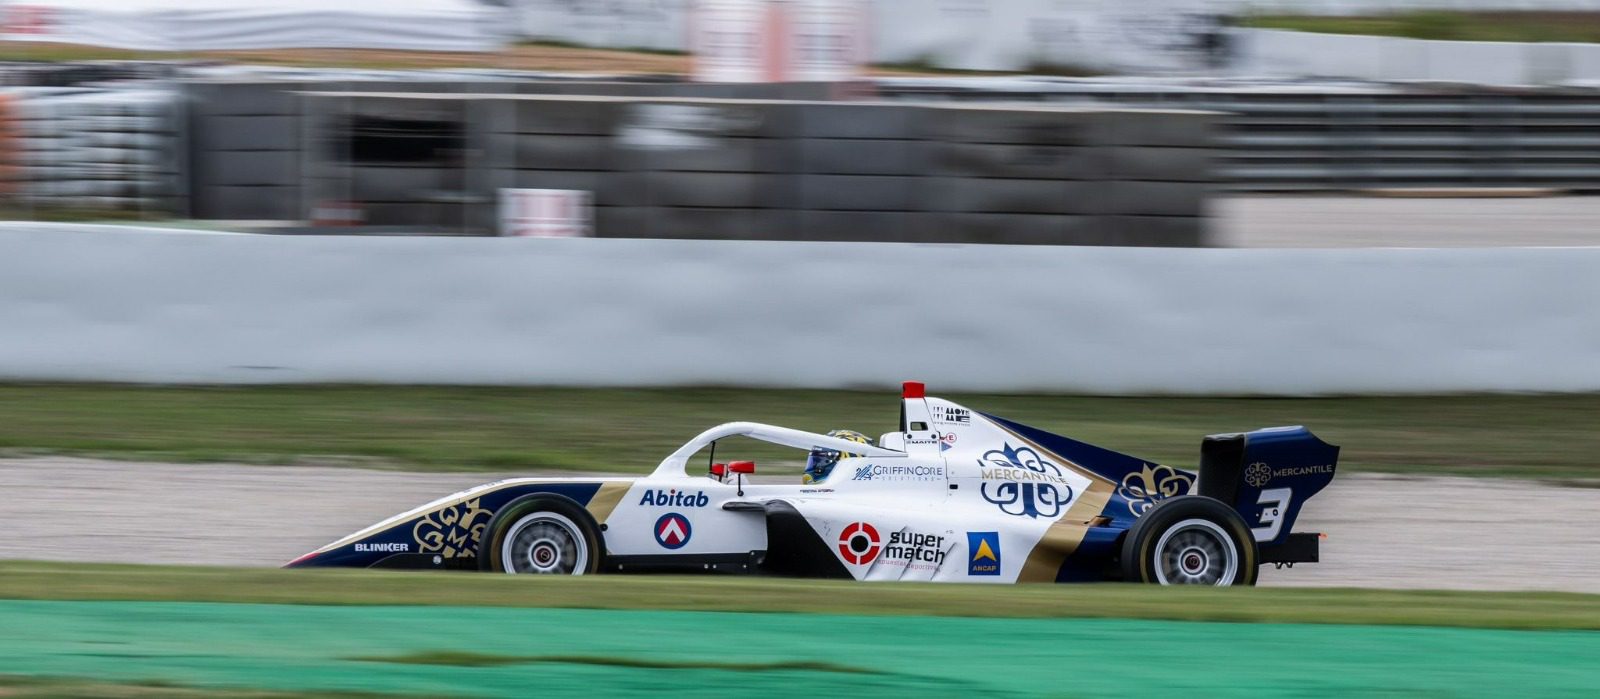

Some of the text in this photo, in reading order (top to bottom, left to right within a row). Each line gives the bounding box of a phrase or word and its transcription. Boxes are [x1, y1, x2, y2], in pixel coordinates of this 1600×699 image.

[981, 468, 1069, 485] MERCANTILE
[1273, 464, 1332, 477] MERCANTILE
[639, 489, 709, 508] Abitab
[1251, 487, 1292, 541] 3
[354, 542, 409, 552] BLINKER
[889, 531, 944, 548] super
[885, 544, 946, 565] match
